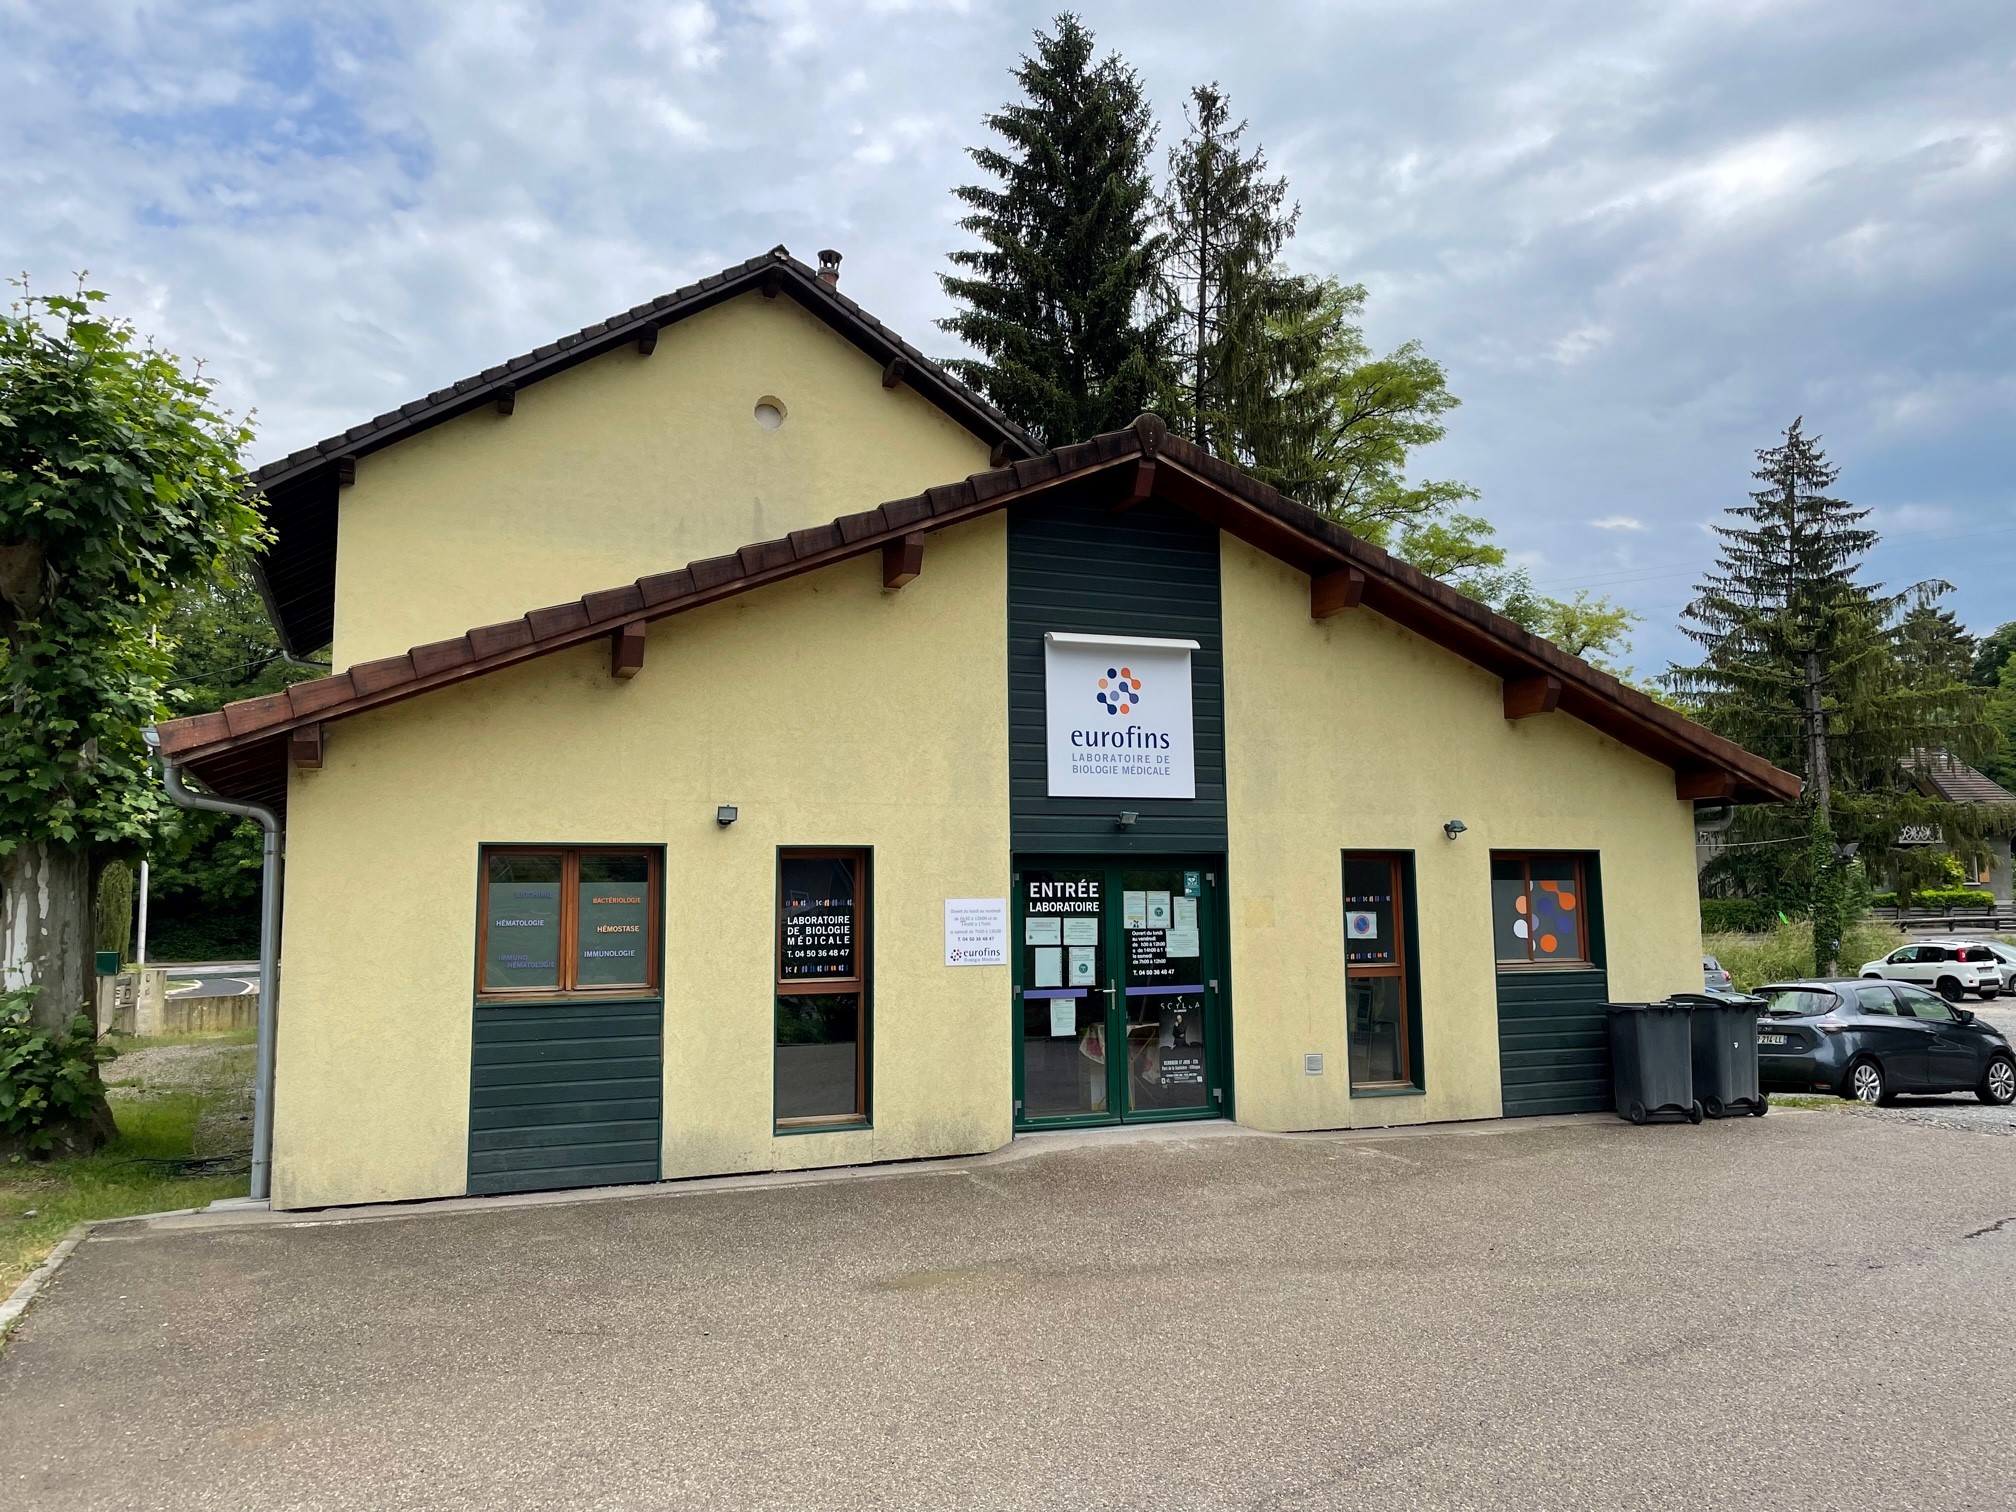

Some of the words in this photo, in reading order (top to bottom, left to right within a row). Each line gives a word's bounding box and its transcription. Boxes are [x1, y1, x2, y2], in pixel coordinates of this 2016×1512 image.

[1071, 726, 1170, 749] eurofins
[1072, 753, 1150, 764] LABORATOIRE
[1156, 755, 1170, 764] DE
[1072, 765, 1118, 774] BIOLOGIE
[1122, 764, 1170, 775] MÉDICALE
[1030, 879, 1099, 897] ENTRÉE
[1030, 902, 1100, 912] LABORATOIRE
[496, 919, 544, 927] HÉMATOLOGIE
[787, 916, 850, 925] LABORATOIRE
[597, 924, 640, 932] HÉMOSTASE
[788, 926, 800, 935] DE
[806, 926, 850, 934] BIOLOGIE
[787, 935, 850, 945] MÉDICALE
[584, 950, 635, 958] IMMUNOLOGIE
[964, 948, 1001, 957] eurofins
